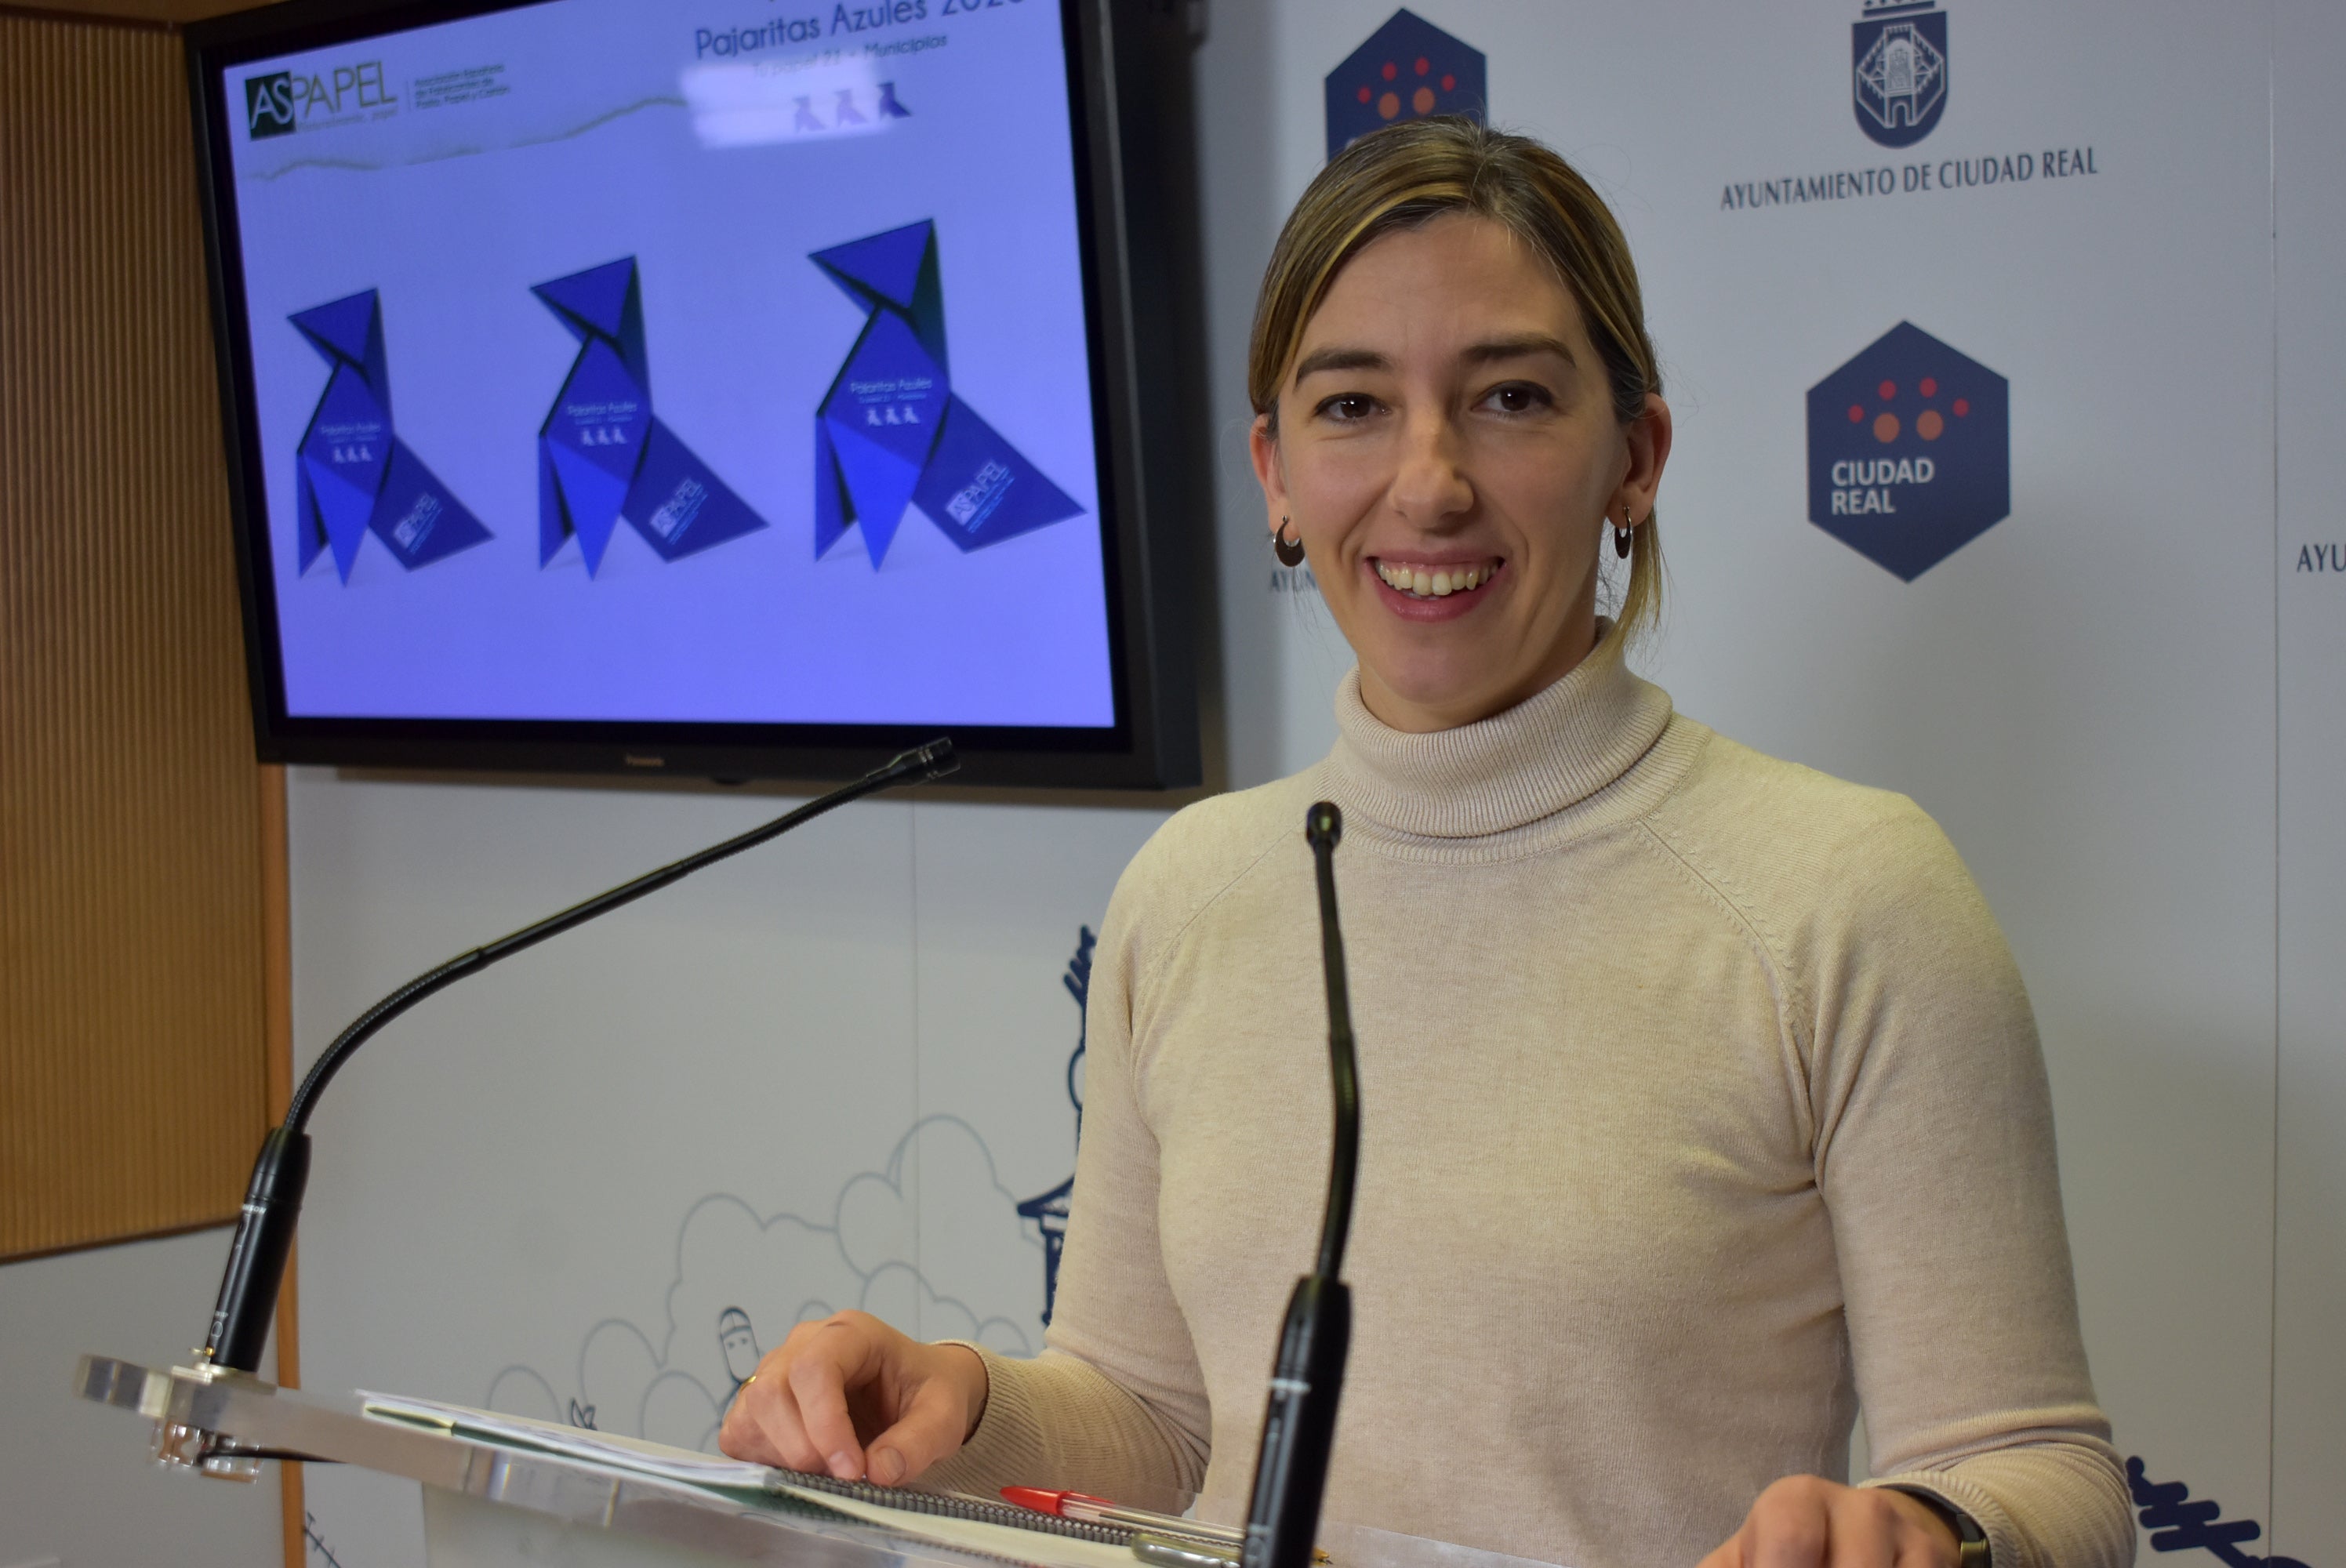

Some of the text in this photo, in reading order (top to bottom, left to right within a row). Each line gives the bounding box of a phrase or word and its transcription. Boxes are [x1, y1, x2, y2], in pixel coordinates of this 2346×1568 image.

[695, 0, 928, 60] Pajaritas Azules
[249, 60, 398, 130] ASPAPEL
[1721, 146, 2097, 210] AYUNTAMIENTO DE CIUDAD REAL
[1832, 457, 1935, 486] CIUDAD
[1832, 488, 1896, 515] REAL
